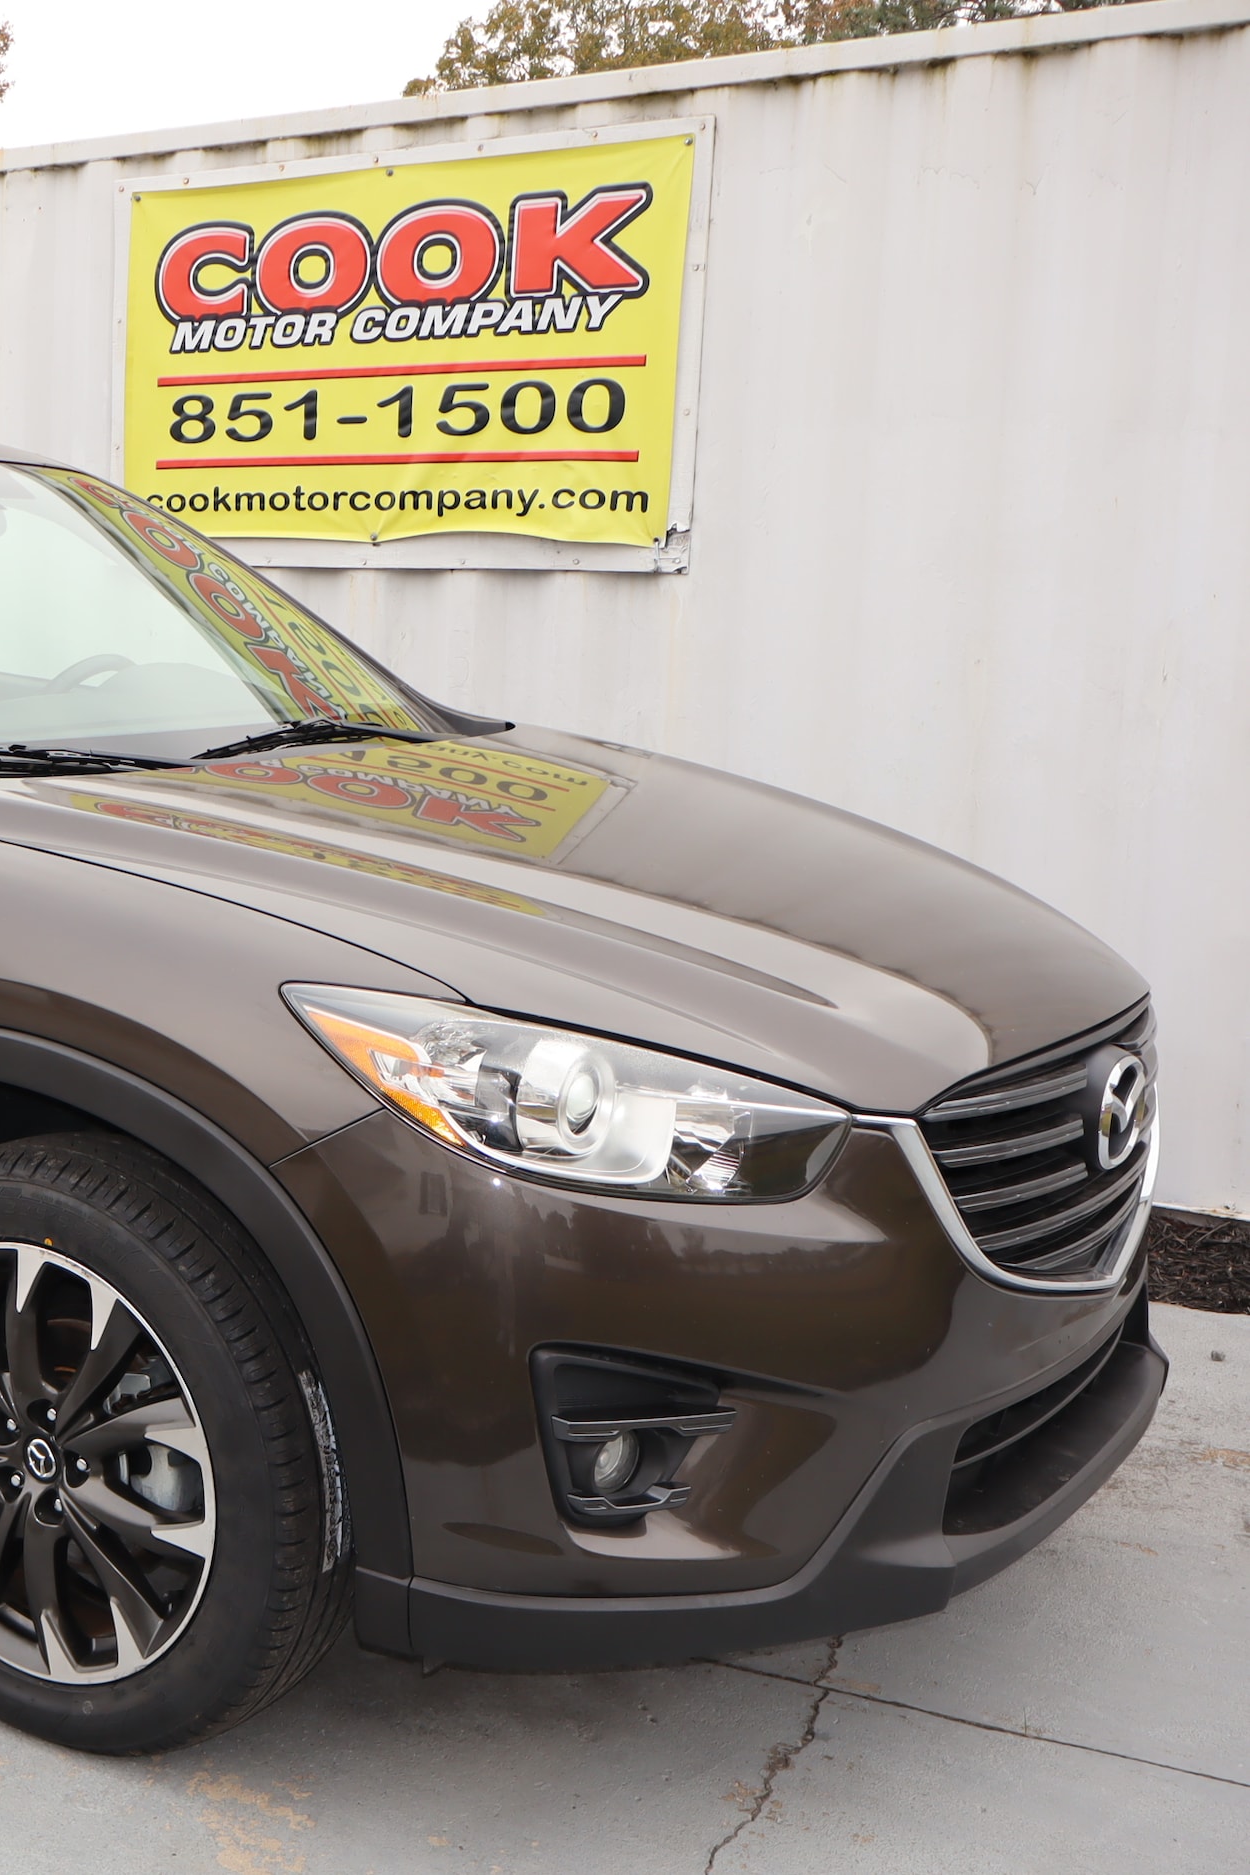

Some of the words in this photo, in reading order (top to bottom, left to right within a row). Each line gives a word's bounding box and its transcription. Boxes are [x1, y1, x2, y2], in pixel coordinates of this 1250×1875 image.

[156, 181, 653, 324] COOK
[170, 311, 338, 354] MOTOR
[350, 293, 623, 344] COMPANY
[168, 378, 625, 444] 851-1500
